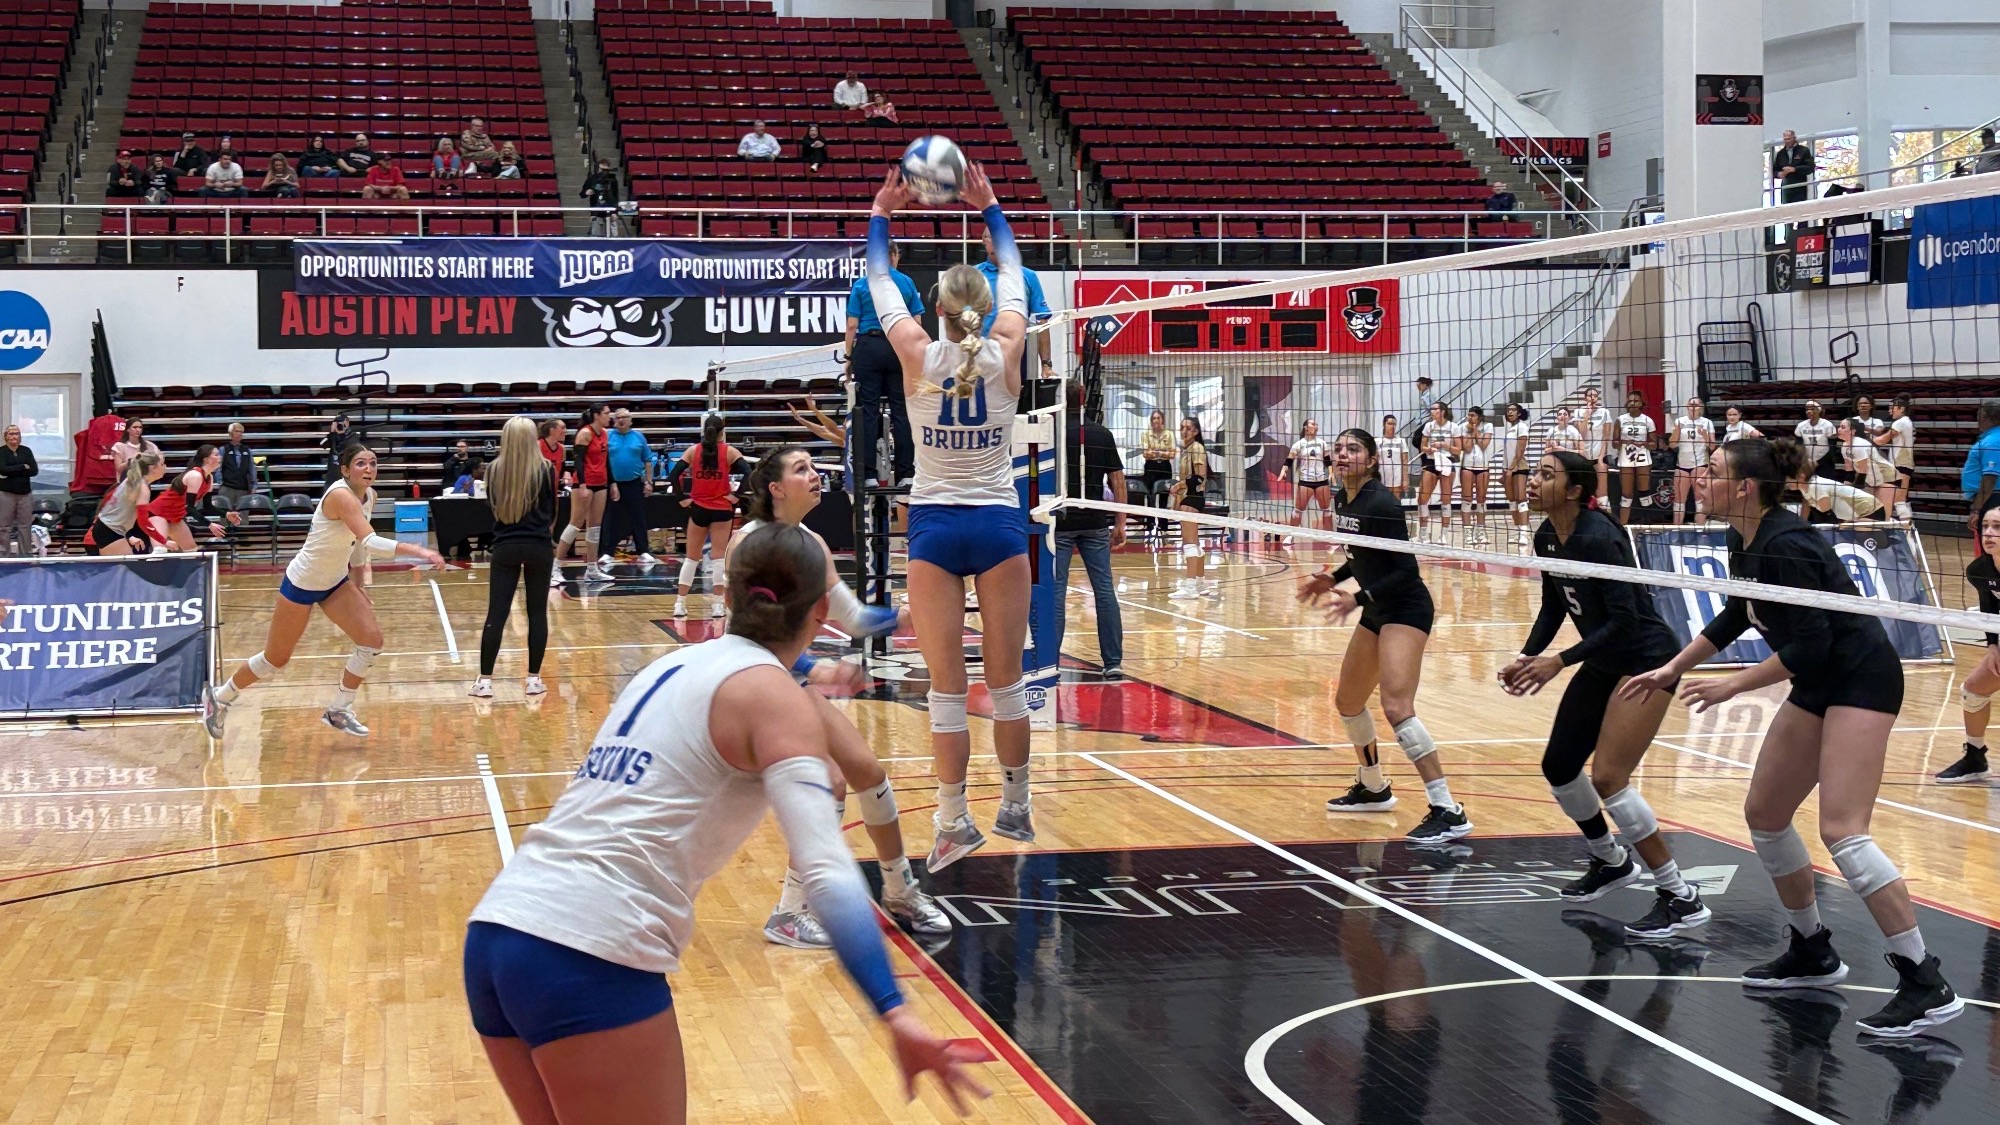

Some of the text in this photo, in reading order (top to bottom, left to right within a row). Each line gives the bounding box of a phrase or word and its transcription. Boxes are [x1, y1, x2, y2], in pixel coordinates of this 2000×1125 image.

[300, 255, 535, 279] OPPORTUNITIES START HERE
[560, 250, 634, 287] NJCAA
[659, 257, 784, 280] OPPORTUNITIES
[788, 258, 833, 281] START
[281, 292, 517, 336] AUSTIN PEAY
[937, 376, 988, 426] 10
[921, 425, 1003, 450] BRUINS
[1627, 427, 1640, 437] 22
[0, 598, 204, 633] TUNITIES
[1562, 585, 1583, 617] 5
[46, 637, 158, 670] HERE
[616, 664, 686, 737] 1
